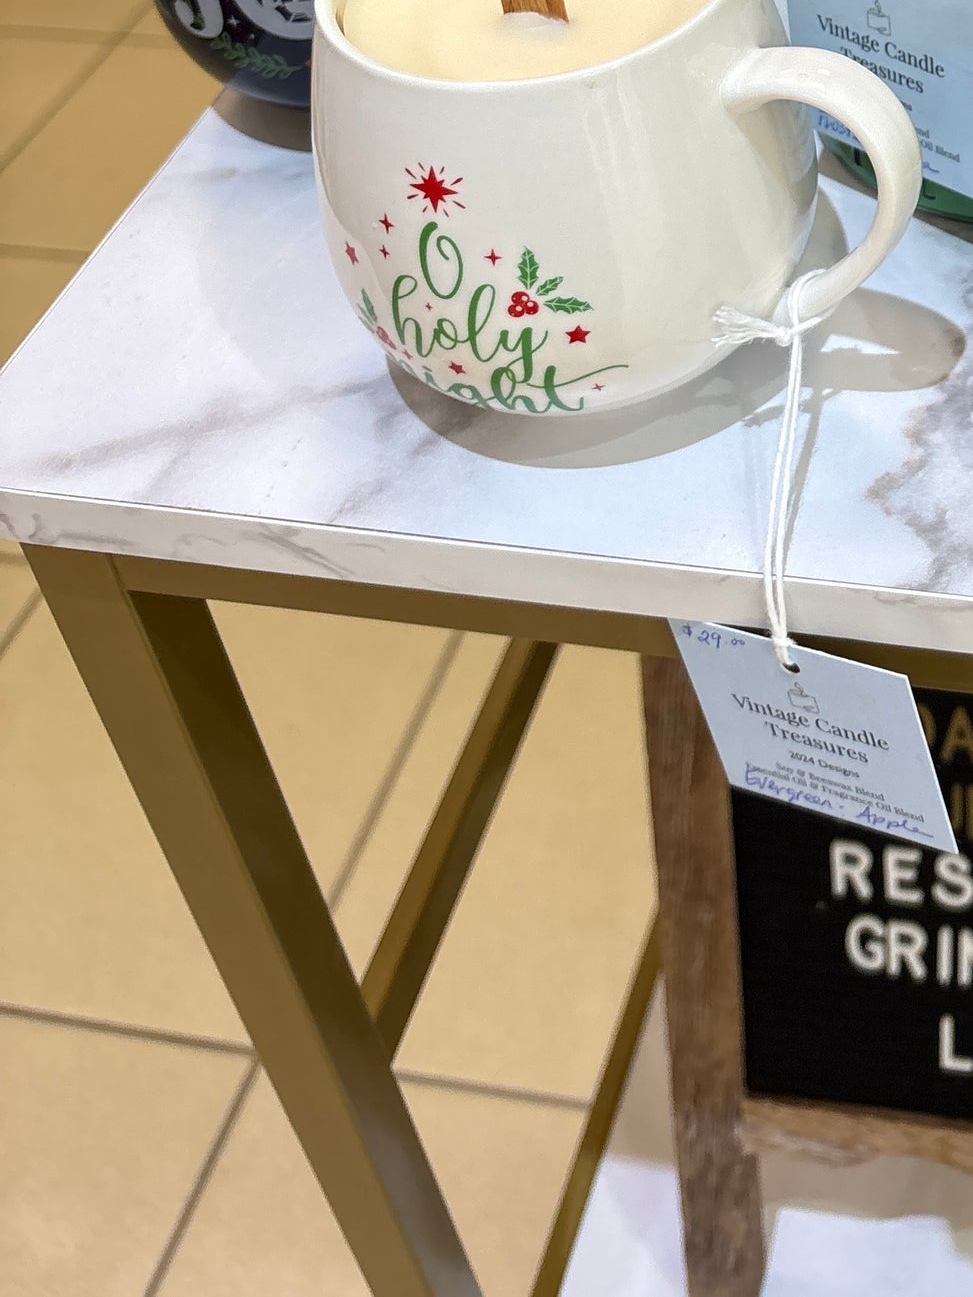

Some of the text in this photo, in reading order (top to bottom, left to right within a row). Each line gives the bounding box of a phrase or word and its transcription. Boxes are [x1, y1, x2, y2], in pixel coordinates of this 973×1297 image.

[816, 13, 946, 79] Vintage Candle
[418, 221, 464, 300] O
[391, 274, 549, 384] holy
[730, 693, 890, 751] Vintage Candle
[763, 720, 870, 764] Treasures
